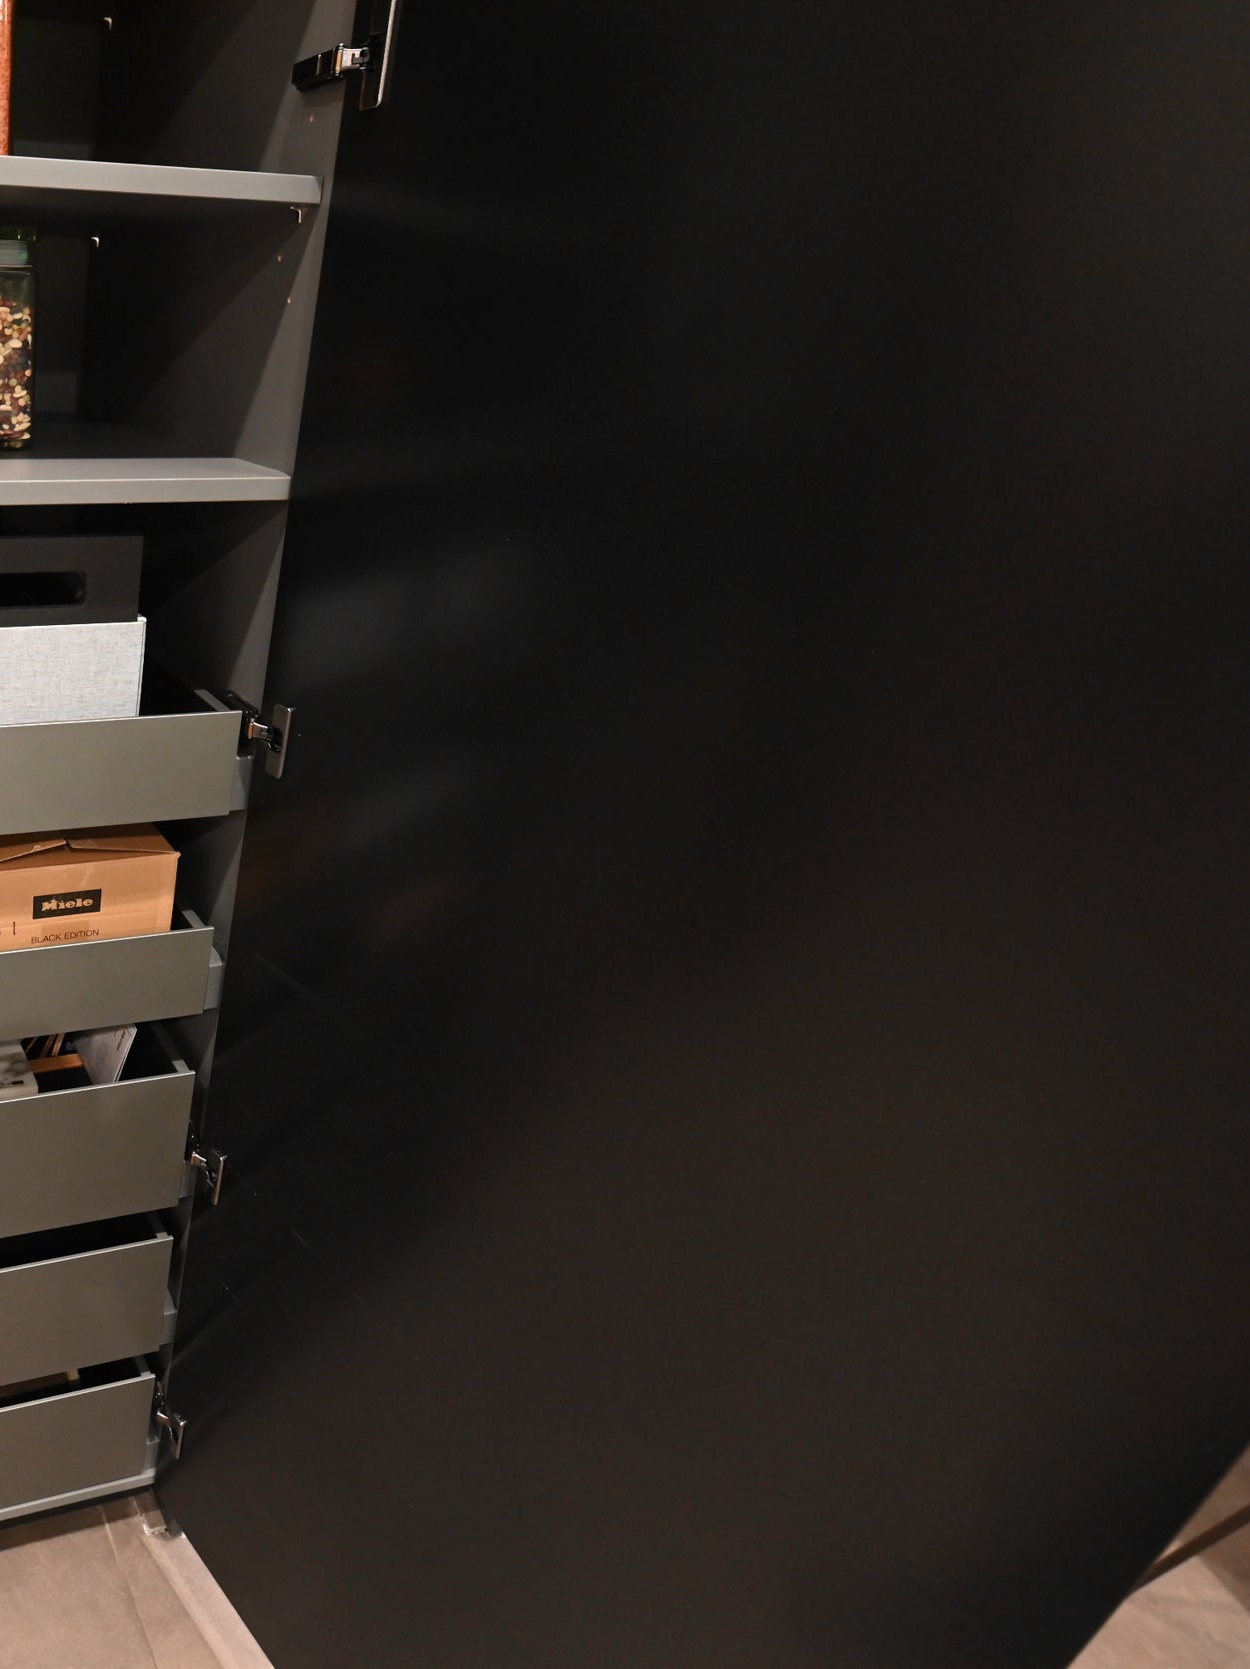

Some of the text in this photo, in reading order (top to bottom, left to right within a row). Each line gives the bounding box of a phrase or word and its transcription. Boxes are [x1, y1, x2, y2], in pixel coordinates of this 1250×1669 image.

[41, 897, 94, 912] Miele
[31, 928, 100, 944] BLACK EDITION
